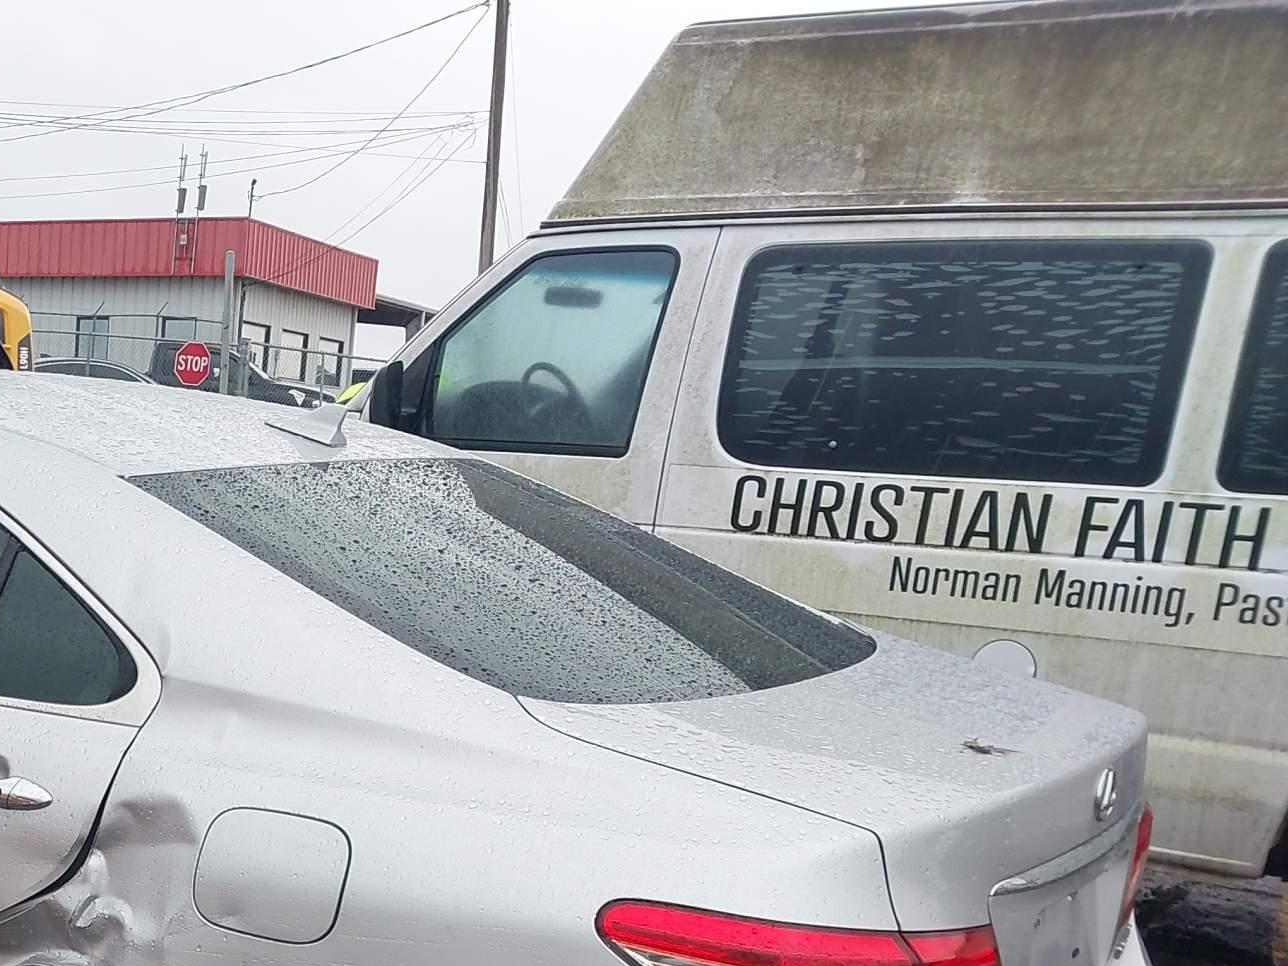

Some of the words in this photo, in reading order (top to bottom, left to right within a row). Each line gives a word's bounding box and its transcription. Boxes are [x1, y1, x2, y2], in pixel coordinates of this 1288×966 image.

[177, 355, 209, 373] STOP
[730, 474, 1054, 555] CHRISTIAN
[1073, 496, 1272, 571] FAITH
[888, 555, 1020, 604] Norman
[1034, 568, 1196, 628] Manning,
[1212, 582, 1288, 627] Pas
